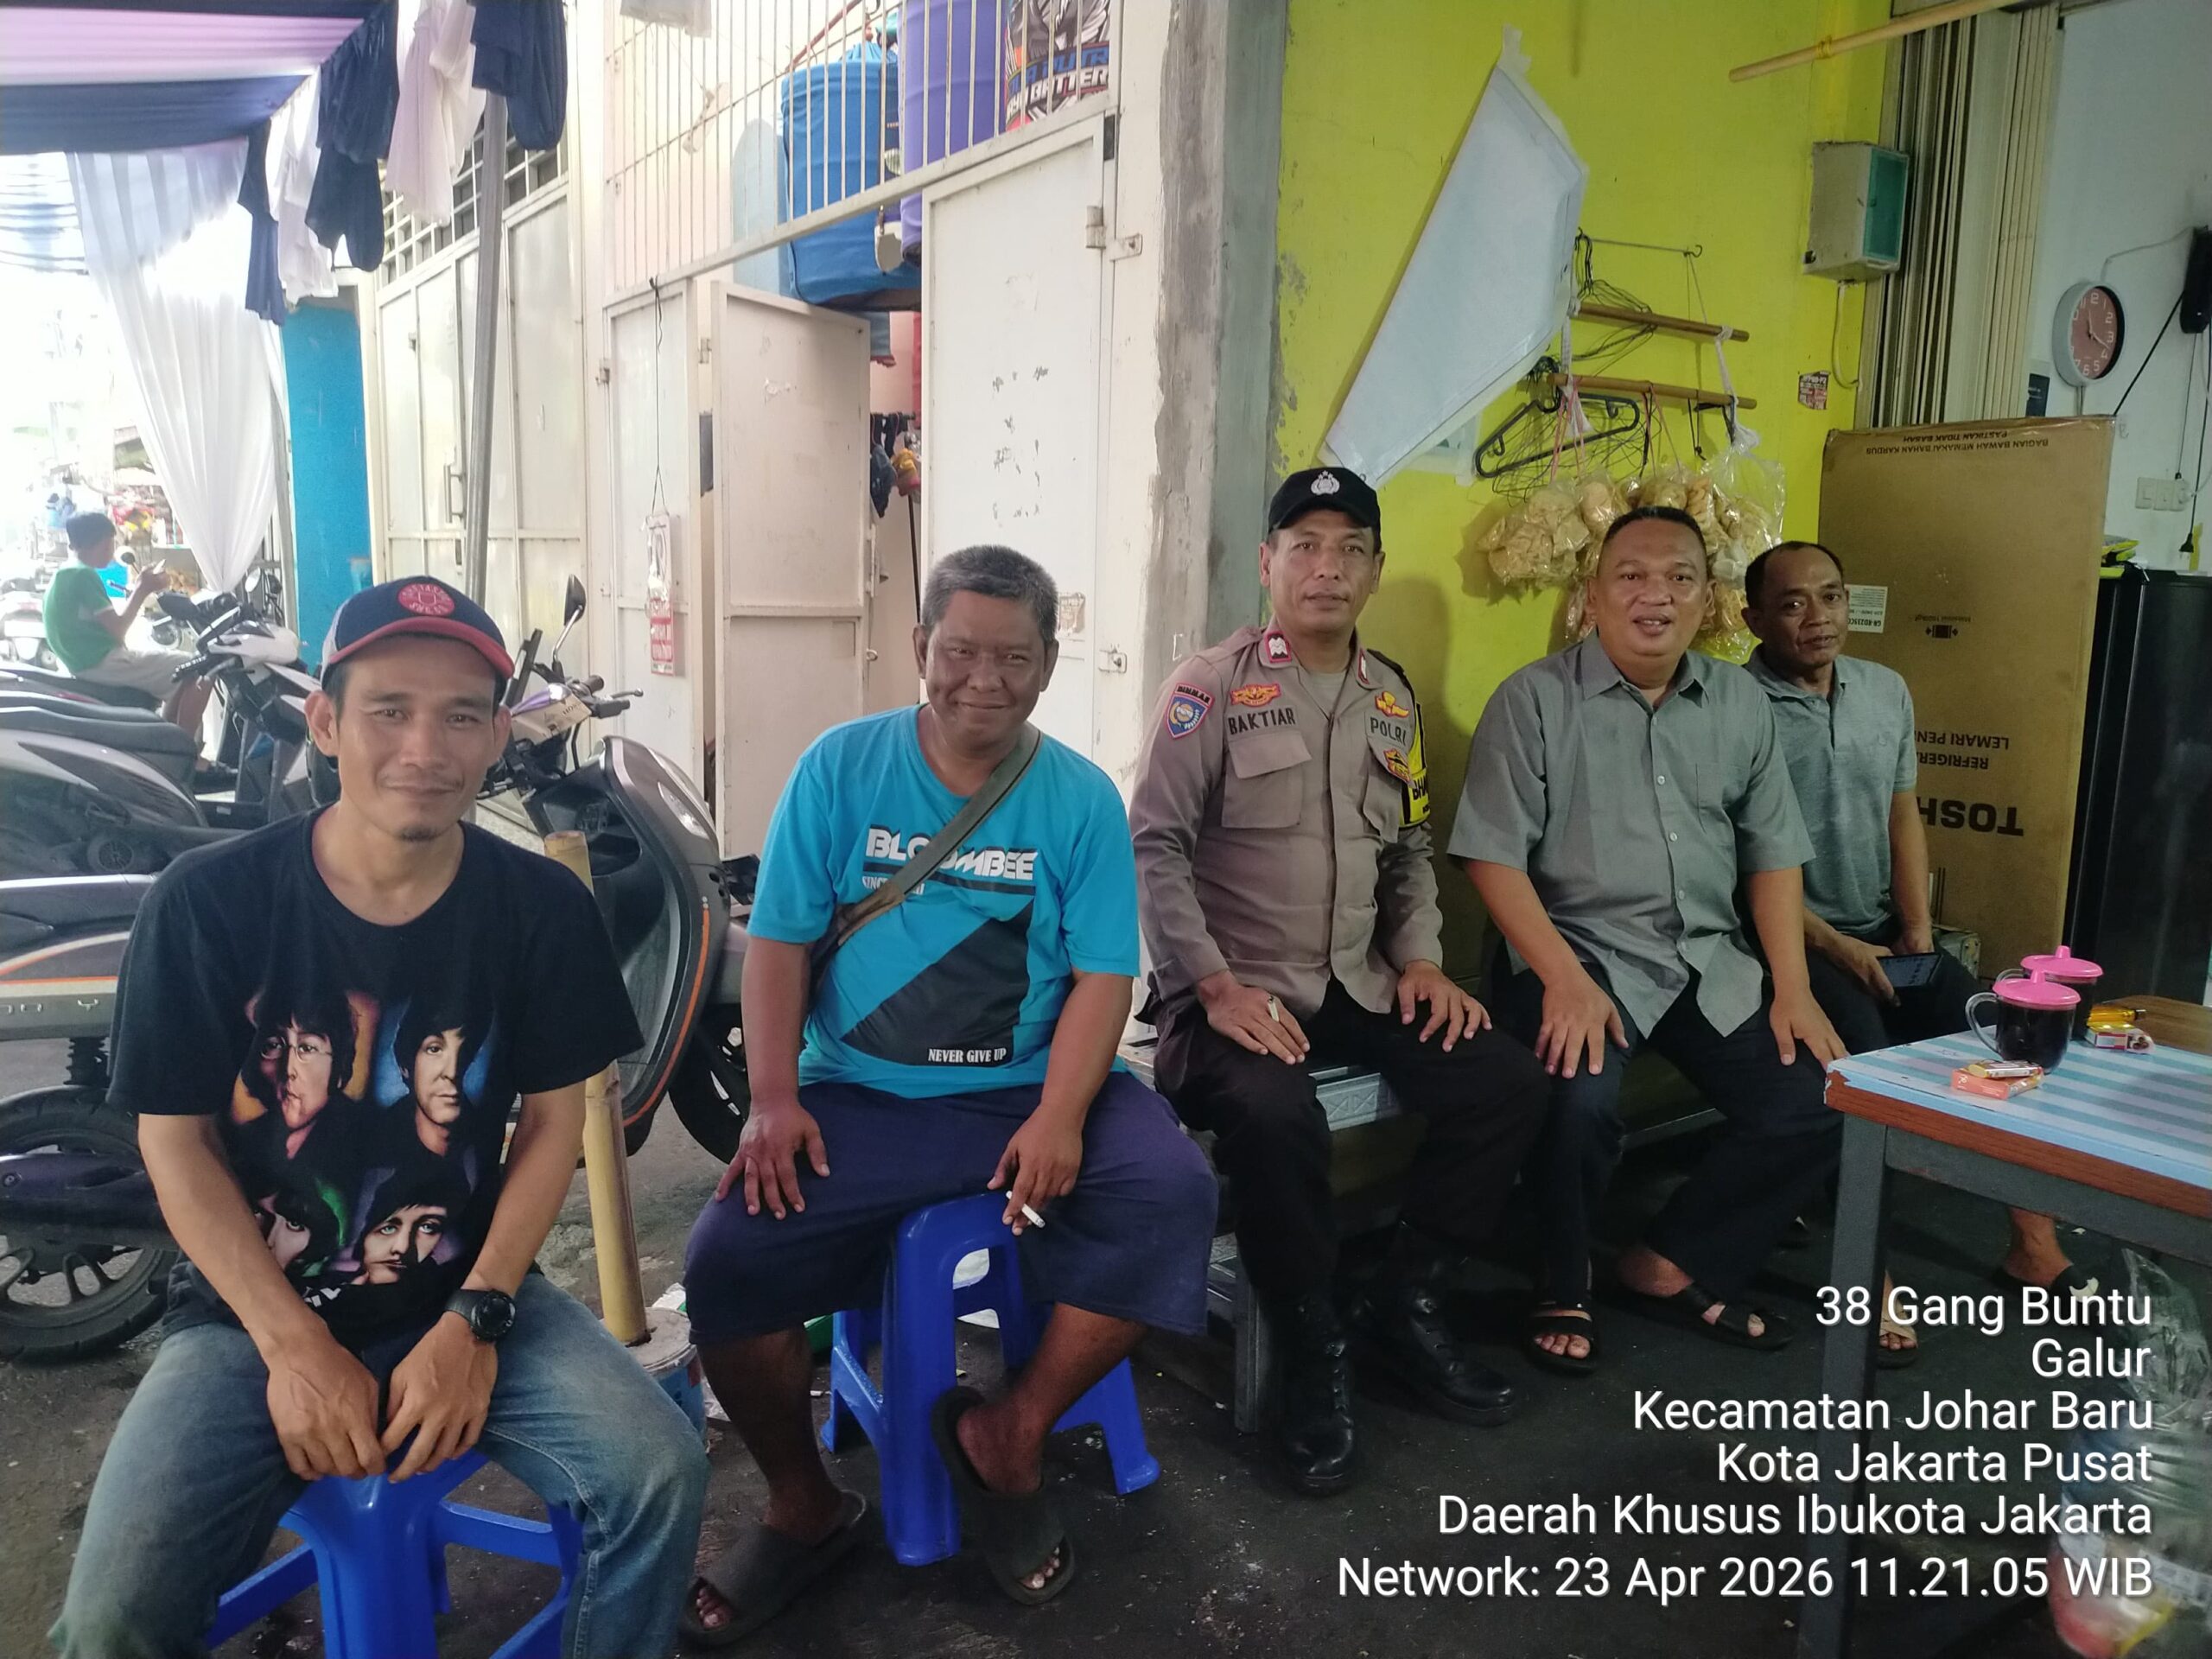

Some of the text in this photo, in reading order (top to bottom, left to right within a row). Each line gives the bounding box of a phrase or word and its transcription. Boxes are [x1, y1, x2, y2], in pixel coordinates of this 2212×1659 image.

[2105, 312, 2113, 324] 2
[2107, 331, 2114, 344] 3
[2101, 348, 2108, 359] 4
[1963, 430, 2007, 441] PASTIKAN
[1933, 443, 1974, 452] MEMAKAI
[1977, 441, 2011, 449] BAWAH
[2013, 439, 2049, 448] BAGIAN
[1866, 446, 1899, 454] KARDUS
[1228, 708, 1296, 735] BAKTIAR
[1370, 716, 1407, 747] POLRI
[1915, 730, 2009, 750] LEMARI PEN
[1916, 751, 1988, 770] REFRIGER
[928, 1047, 1007, 1063] NEVER GIVE UP
